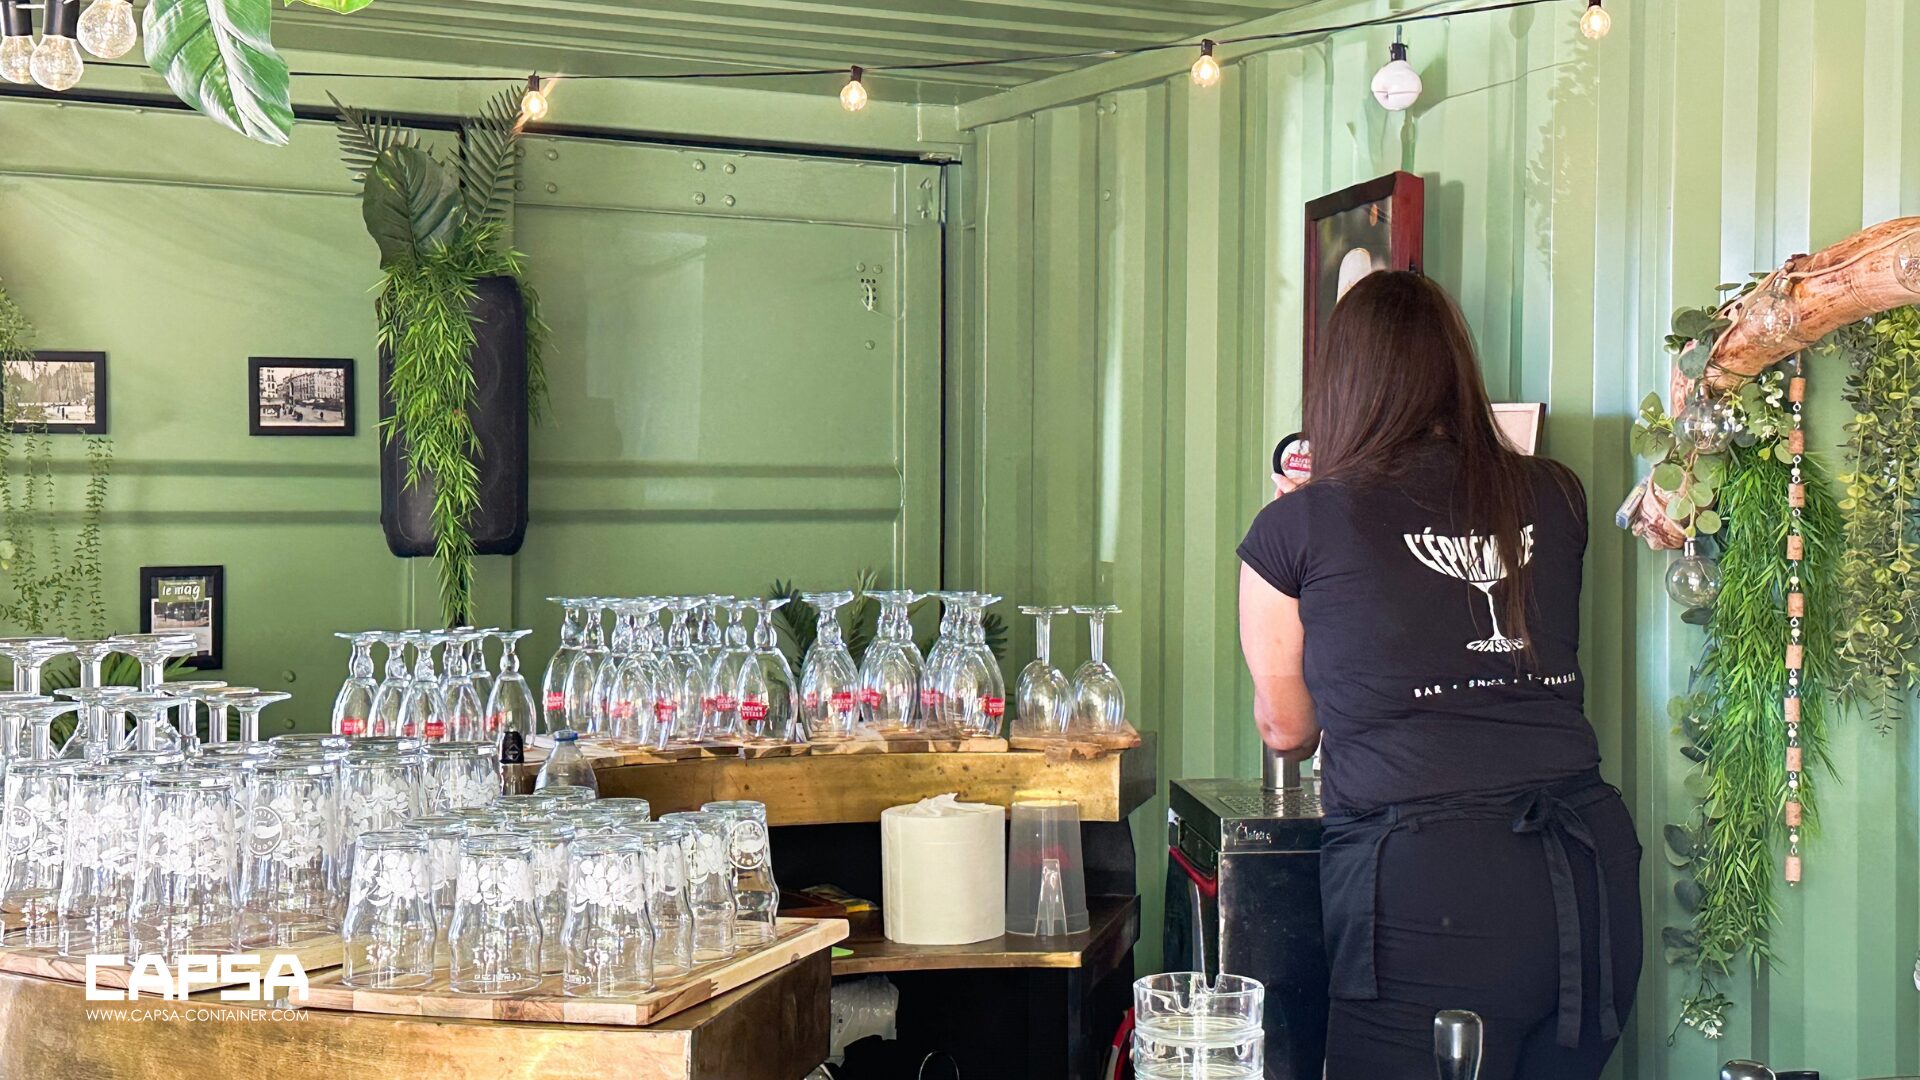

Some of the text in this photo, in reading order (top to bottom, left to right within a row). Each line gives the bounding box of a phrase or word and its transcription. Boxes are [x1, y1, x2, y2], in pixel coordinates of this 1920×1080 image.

[1403, 524, 1534, 581] L'ÉPHÉME
[162, 585, 201, 600] le mag
[1414, 684, 1442, 698] BAR
